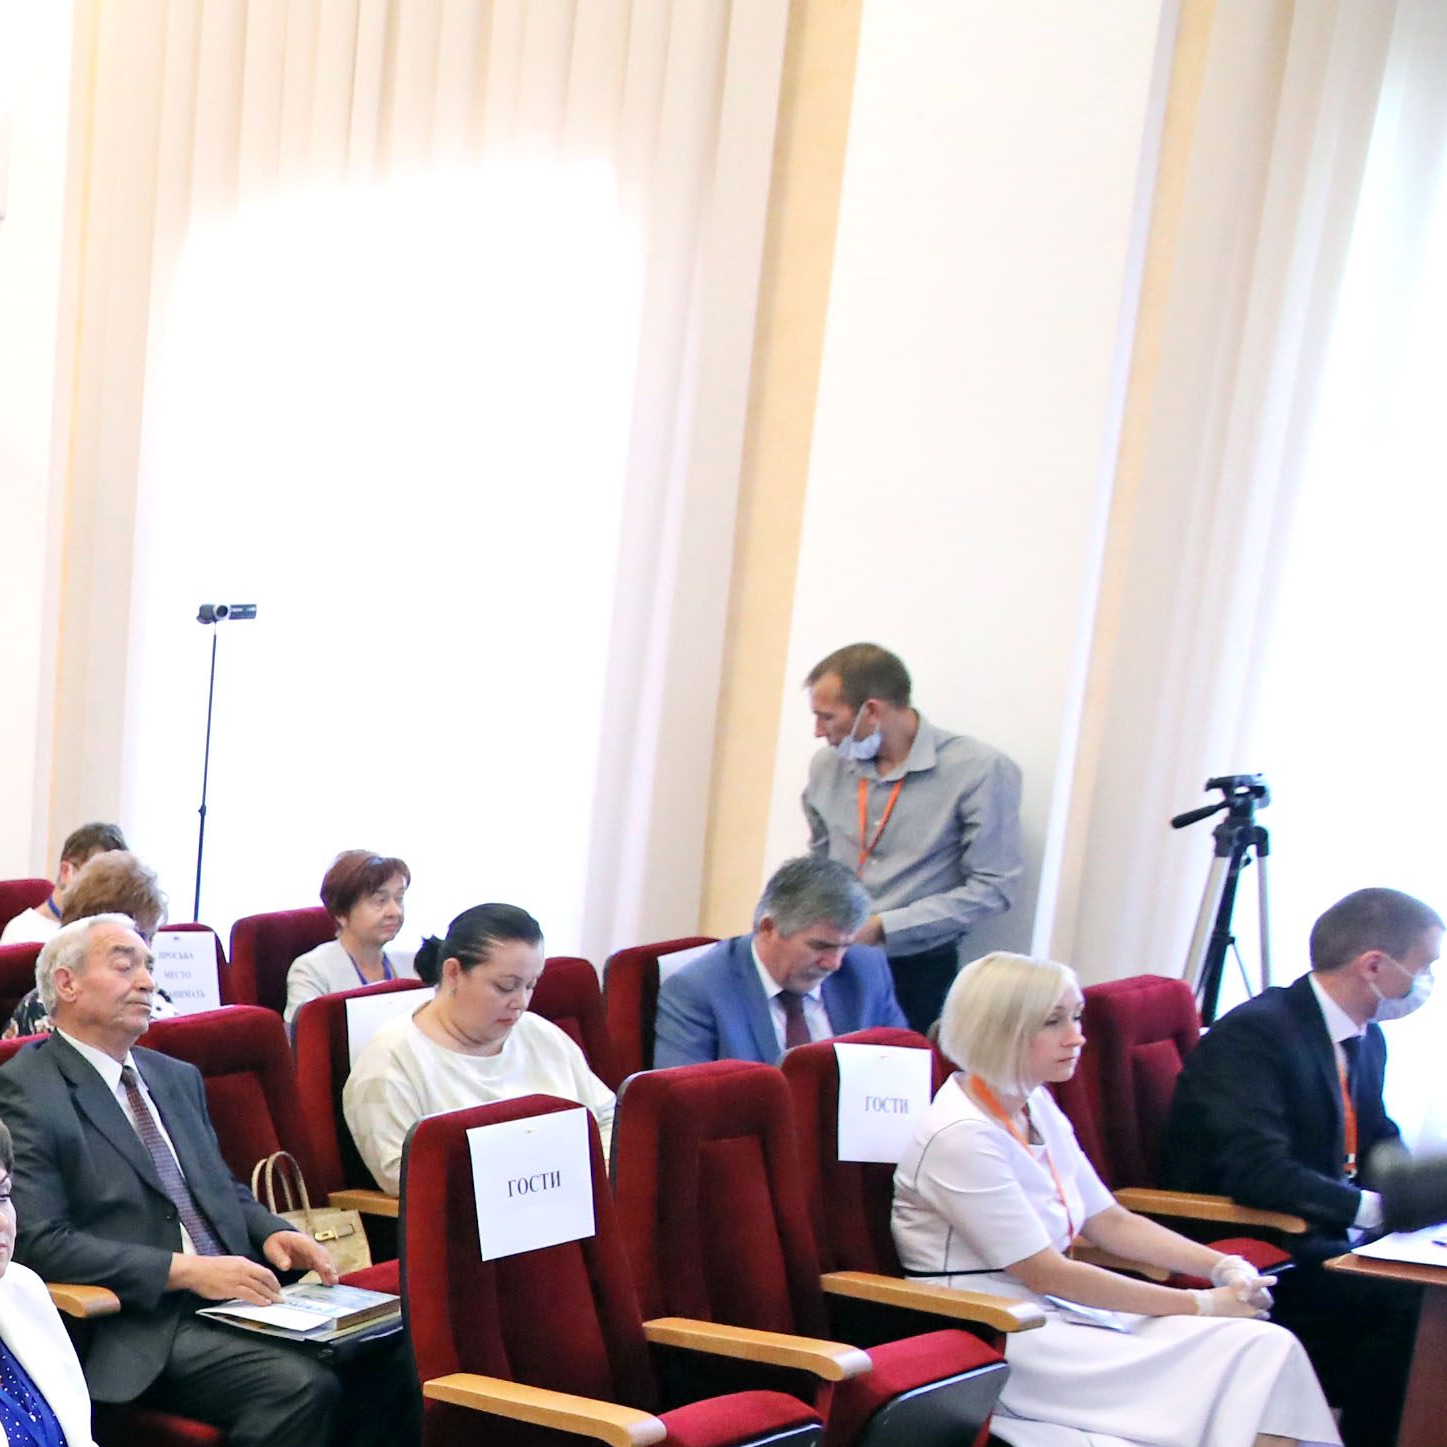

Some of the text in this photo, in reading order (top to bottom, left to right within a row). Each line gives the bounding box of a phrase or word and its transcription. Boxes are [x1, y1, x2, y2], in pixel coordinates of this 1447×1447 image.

[158, 951, 194, 960] ПРОСЬБА
[164, 970, 192, 979] МЕСТО
[169, 989, 206, 999] АНИМАТЬ
[865, 1095, 910, 1114] ГОСТИ
[508, 1170, 561, 1198] ГОСТИ
